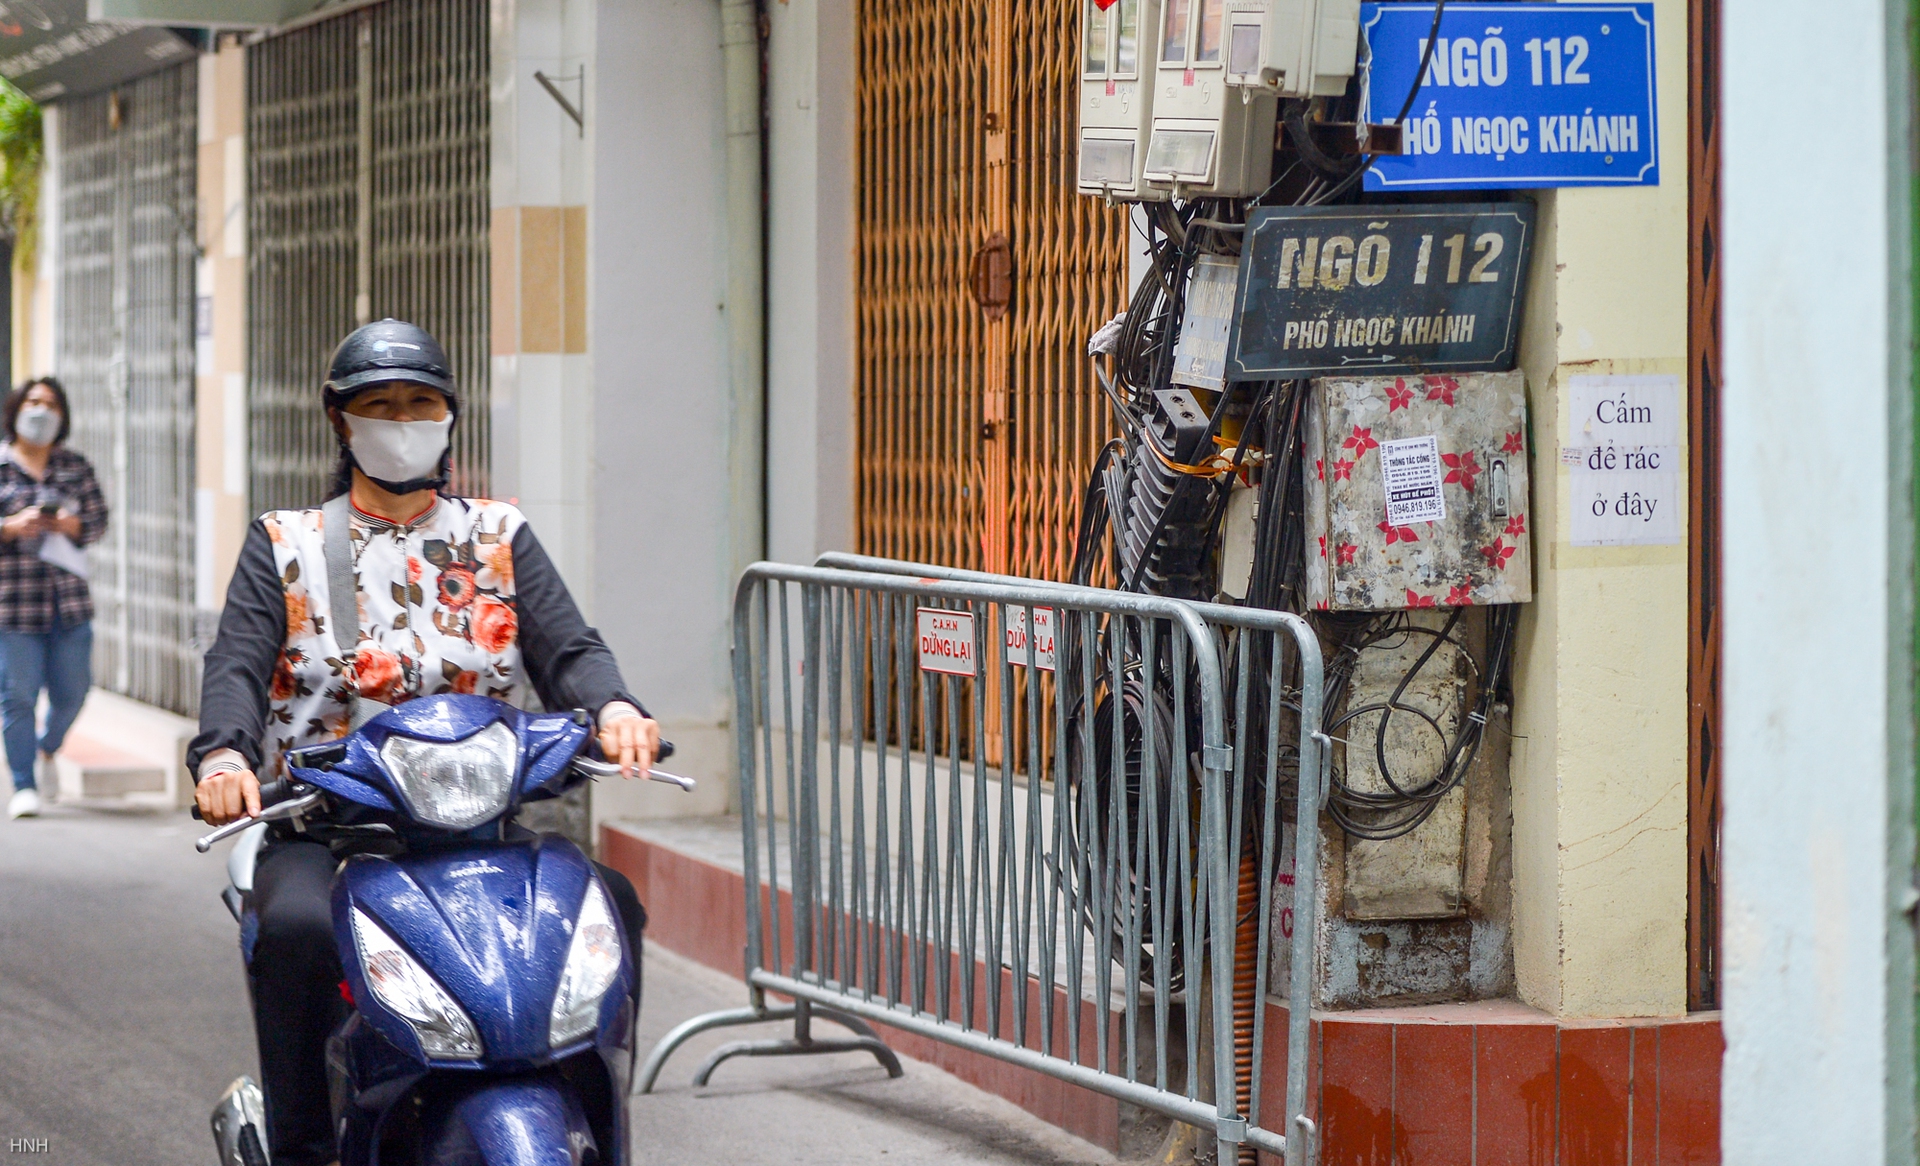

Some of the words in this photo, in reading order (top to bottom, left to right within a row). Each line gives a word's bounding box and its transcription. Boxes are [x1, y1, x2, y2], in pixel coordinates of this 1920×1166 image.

[1418, 26, 1508, 87] NGÕ
[1524, 36, 1590, 86] 112
[1382, 100, 1442, 155] HỐ
[1452, 116, 1529, 161] NGỌC
[1539, 107, 1639, 154] KHÁNH
[1277, 221, 1391, 289] NGÕ
[1413, 232, 1504, 285] 112
[1283, 309, 1328, 350] PHỐ
[1334, 317, 1395, 354] NGỌC
[1400, 308, 1476, 345] KHÁNH
[1596, 392, 1652, 424] Cấm
[1588, 439, 1617, 470] để
[1624, 445, 1661, 470] rác
[1393, 499, 1437, 515] 0946.819.196
[1592, 493, 1608, 517] ở
[1615, 492, 1658, 522] đây
[932, 618, 958, 631] C.A.H.N
[922, 632, 951, 657] DỪNG
[953, 640, 971, 664] LẠI
